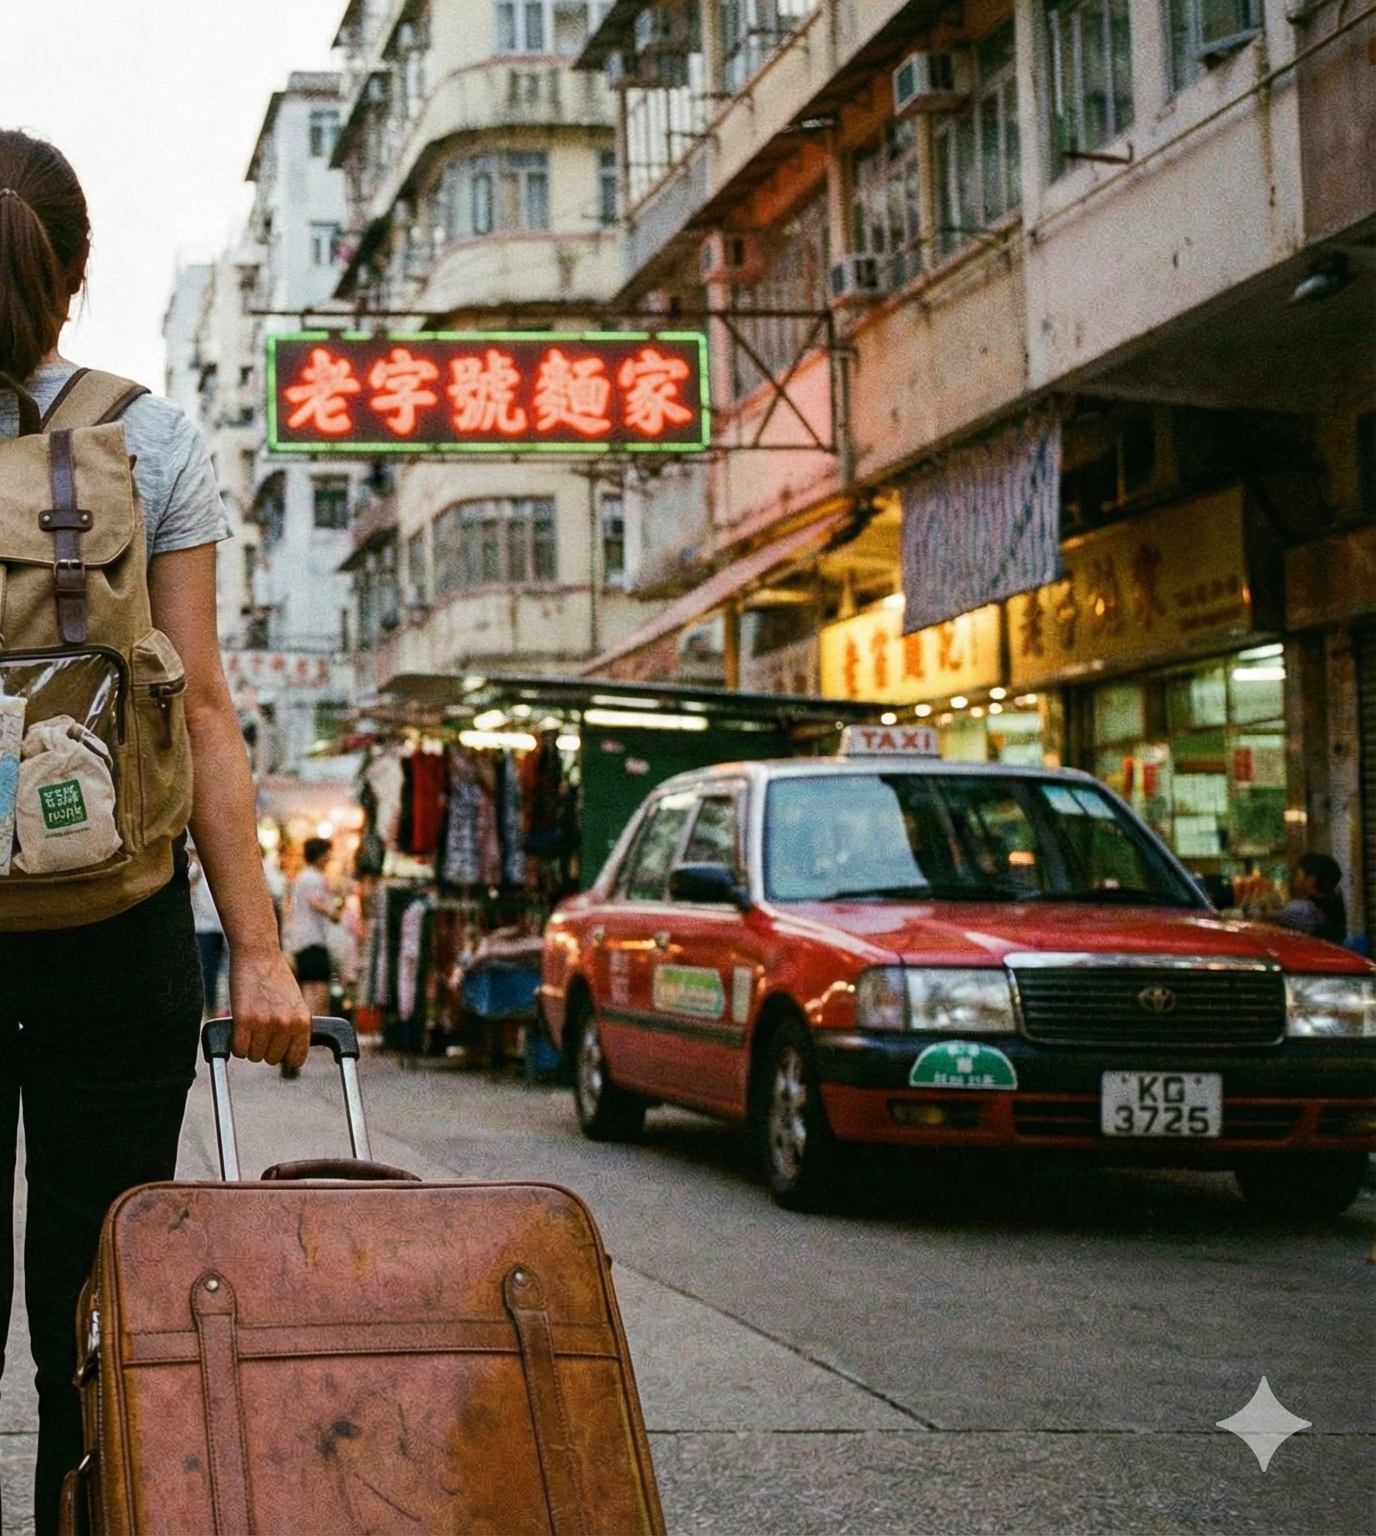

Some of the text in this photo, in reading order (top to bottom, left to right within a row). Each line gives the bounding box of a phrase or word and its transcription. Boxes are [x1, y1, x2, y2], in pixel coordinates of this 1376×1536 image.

[284, 347, 693, 437] 老字號麵家
[861, 730, 931, 752] TAXI
[1114, 1105, 1210, 1134] 3725
